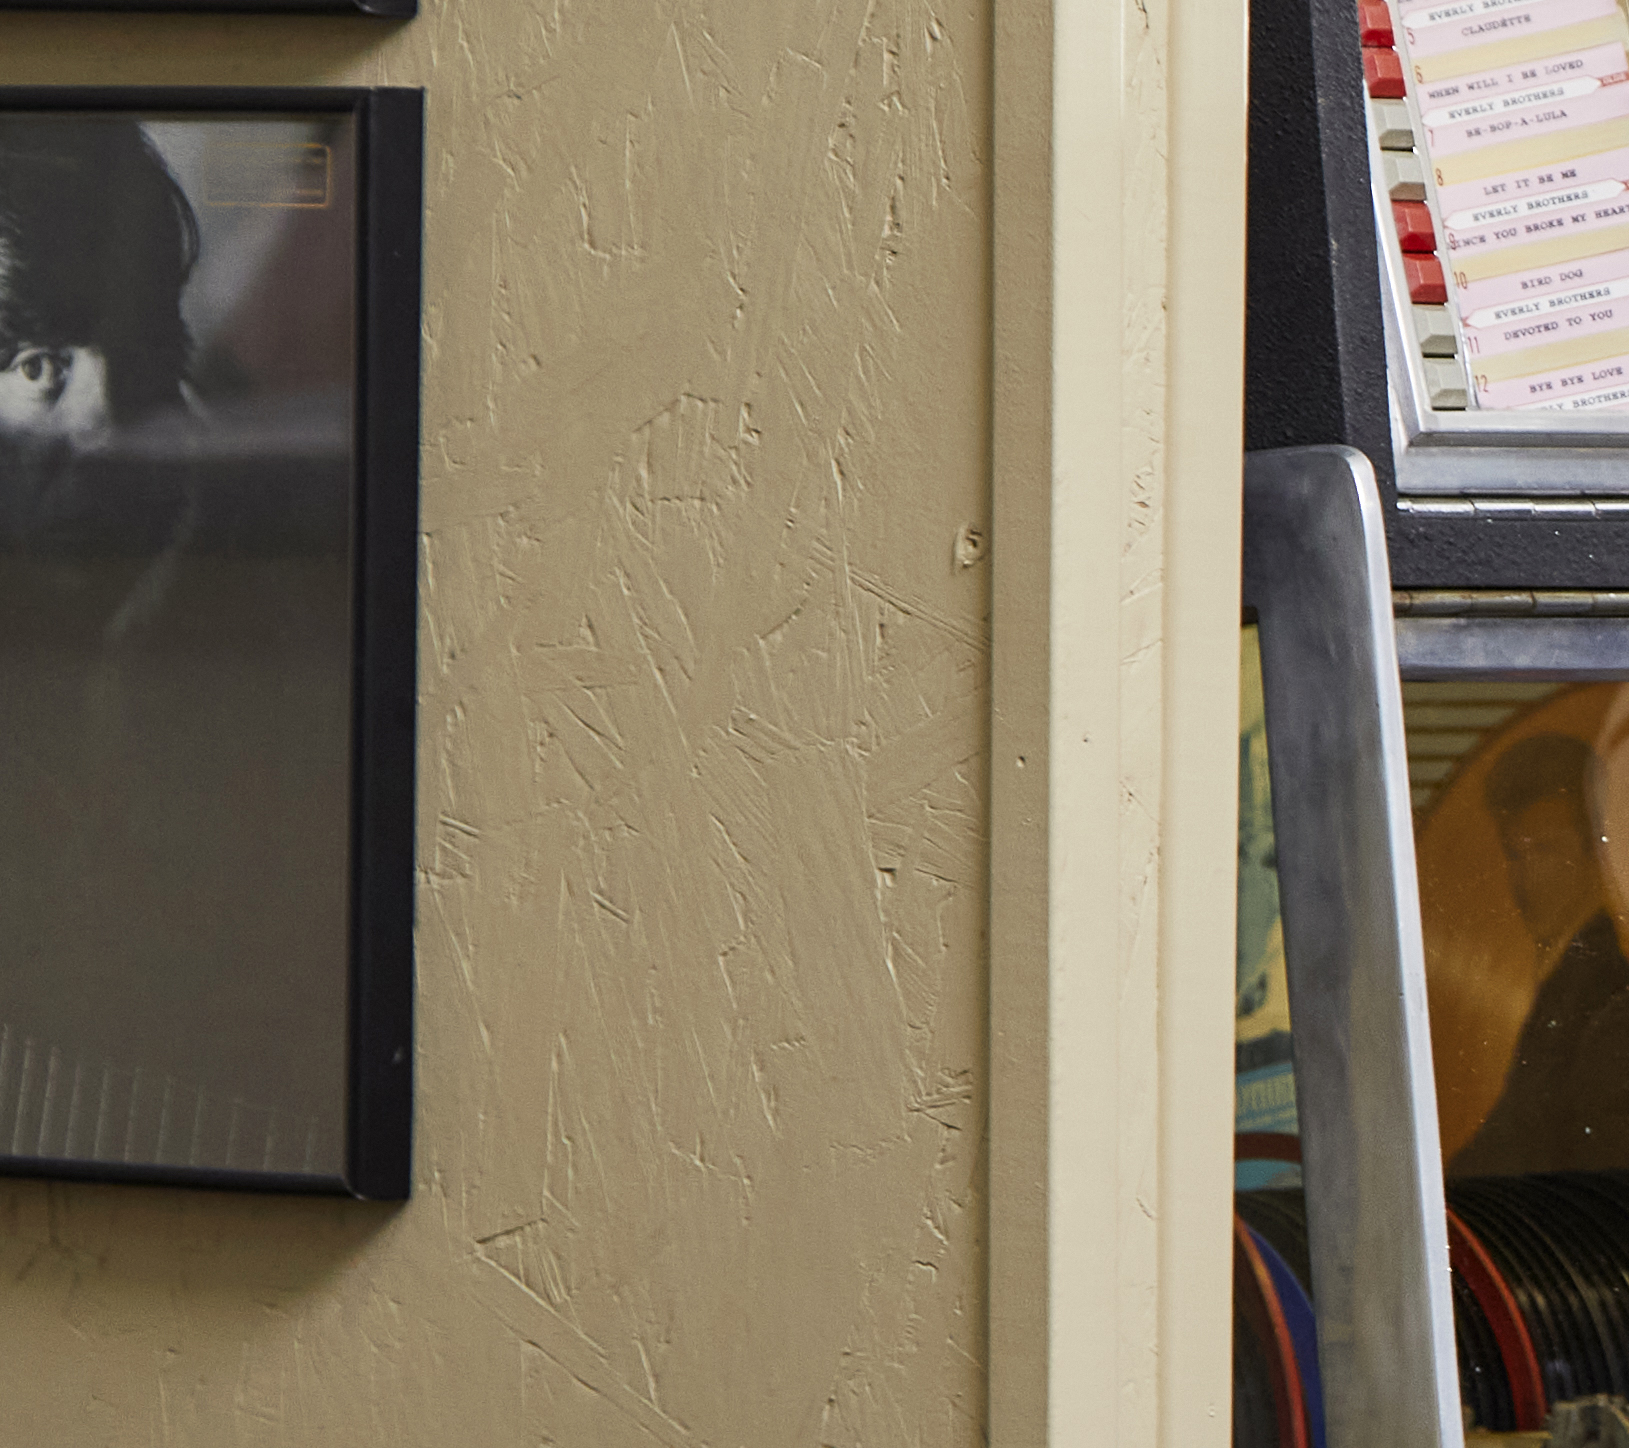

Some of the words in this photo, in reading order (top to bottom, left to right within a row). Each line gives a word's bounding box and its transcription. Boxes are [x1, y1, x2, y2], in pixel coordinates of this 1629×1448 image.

[1428, 3, 1476, 22] EVERLY
[1461, 13, 1532, 36] CLAUDETTE
[1428, 84, 1460, 100] WHEN
[1467, 76, 1499, 92] WILL
[1521, 68, 1537, 80] BE
[1544, 58, 1584, 75] LOVED
[1448, 100, 1495, 120] EVERLY
[1502, 85, 1565, 108] BROTHERS
[1465, 109, 1568, 139] BE-BOP-A-LULA
[1483, 182, 1507, 196] LET
[1514, 178, 1531, 190] IT
[1537, 173, 1554, 185] BE
[1561, 168, 1578, 180] ME
[1471, 203, 1519, 222] EVERLY
[1526, 189, 1589, 211] BROTHERS
[1494, 227, 1518, 241] YOU
[1525, 218, 1564, 235] BROKE
[1571, 213, 1588, 226] MY
[1454, 271, 1467, 289] 10
[1520, 274, 1552, 289] BIRD
[1559, 268, 1584, 282] DOG
[1494, 301, 1542, 319] EVERLY
[1548, 287, 1611, 308] BROTHERS
[1503, 320, 1559, 340] DEVOTED
[1566, 315, 1583, 327] TO
[1589, 309, 1614, 323] YOU
[1468, 337, 1480, 354] 11
[1476, 375, 1488, 393] 12
[1528, 379, 1553, 393] BYE
[1560, 373, 1584, 387] BYE
[1591, 366, 1624, 381] LOVE
